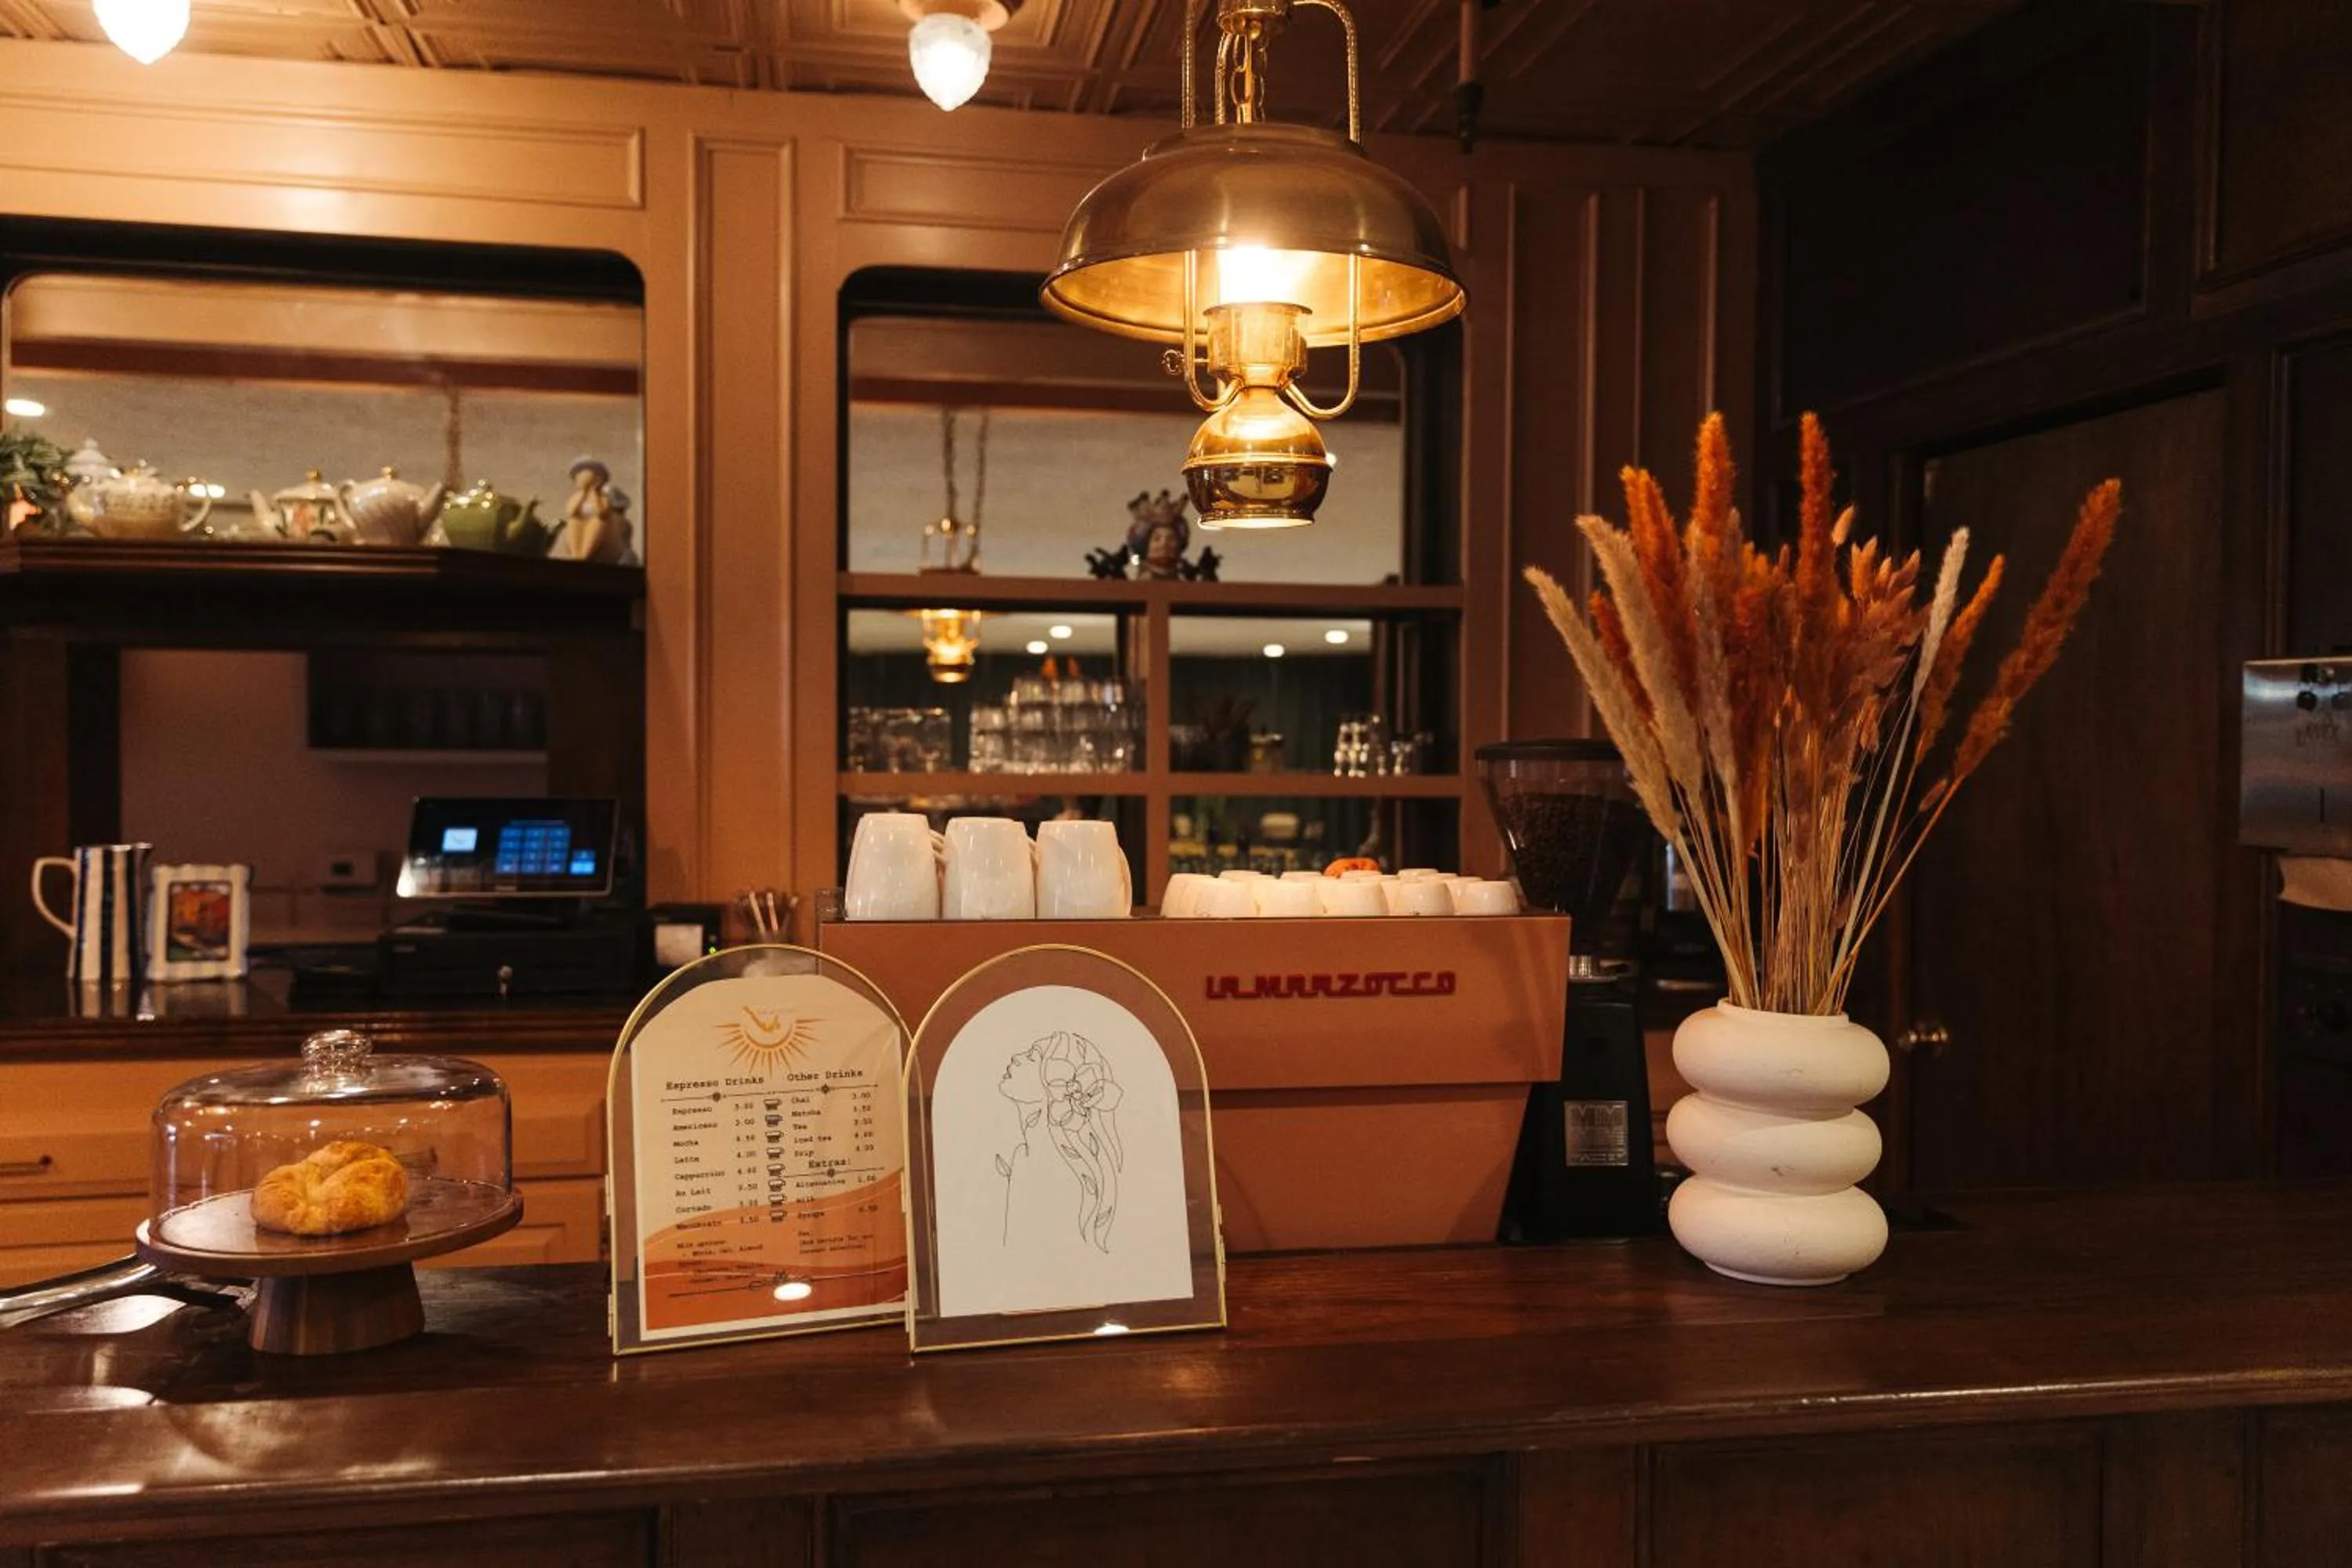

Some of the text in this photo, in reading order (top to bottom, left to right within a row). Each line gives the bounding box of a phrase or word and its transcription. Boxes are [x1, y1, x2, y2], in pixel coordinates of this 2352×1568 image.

[1206, 971, 1457, 1000] LA MARZOCCO
[786, 1069, 863, 1081] Other Drinks
[666, 1076, 764, 1091] Espresso Drinks
[673, 1122, 718, 1131] Americano
[674, 1156, 700, 1164] Latte
[675, 1171, 725, 1181] Cappuccino
